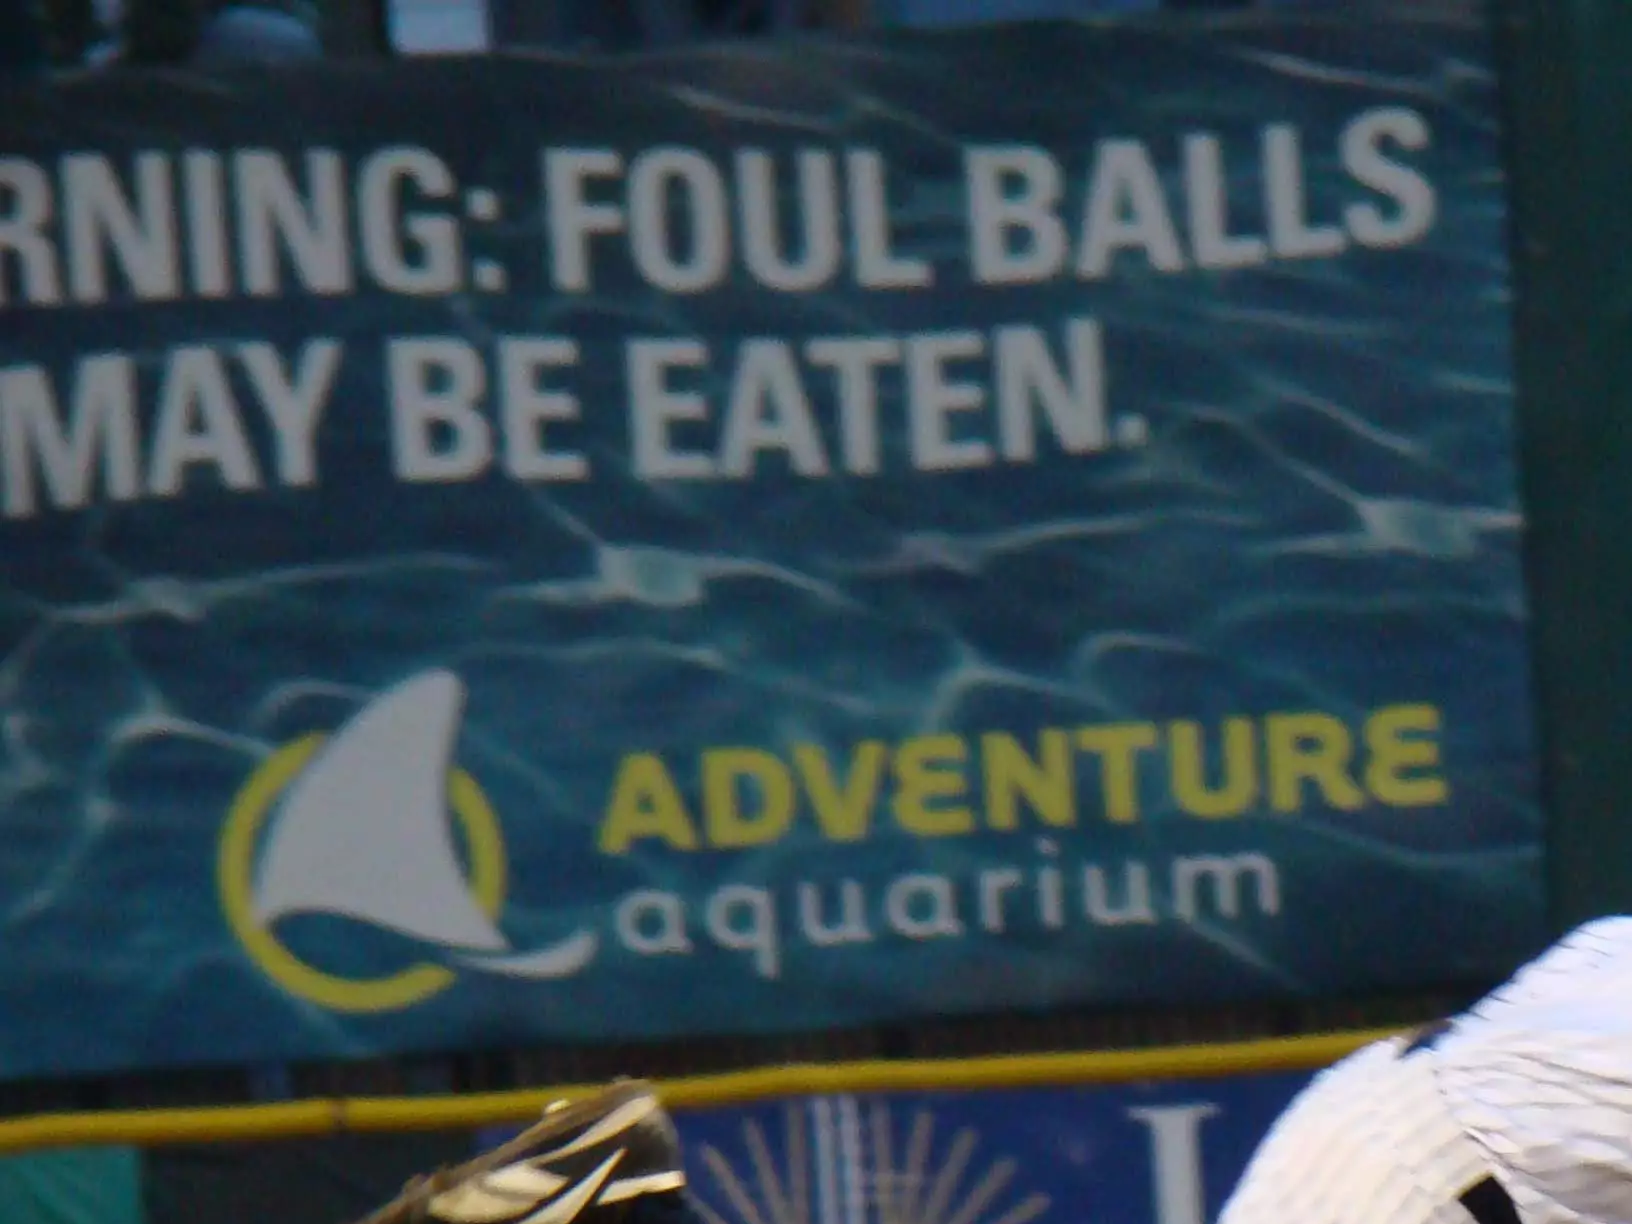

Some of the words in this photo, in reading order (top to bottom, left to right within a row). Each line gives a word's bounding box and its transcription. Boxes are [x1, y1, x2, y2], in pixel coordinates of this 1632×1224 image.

[544, 145, 934, 294] FOUL
[963, 106, 1436, 285] BALLS
[0, 337, 343, 519] MAY
[389, 335, 588, 482] BE
[626, 315, 1148, 481] EATEN.
[598, 704, 1449, 855] ADVENTURE
[615, 840, 1281, 980] aquarium
